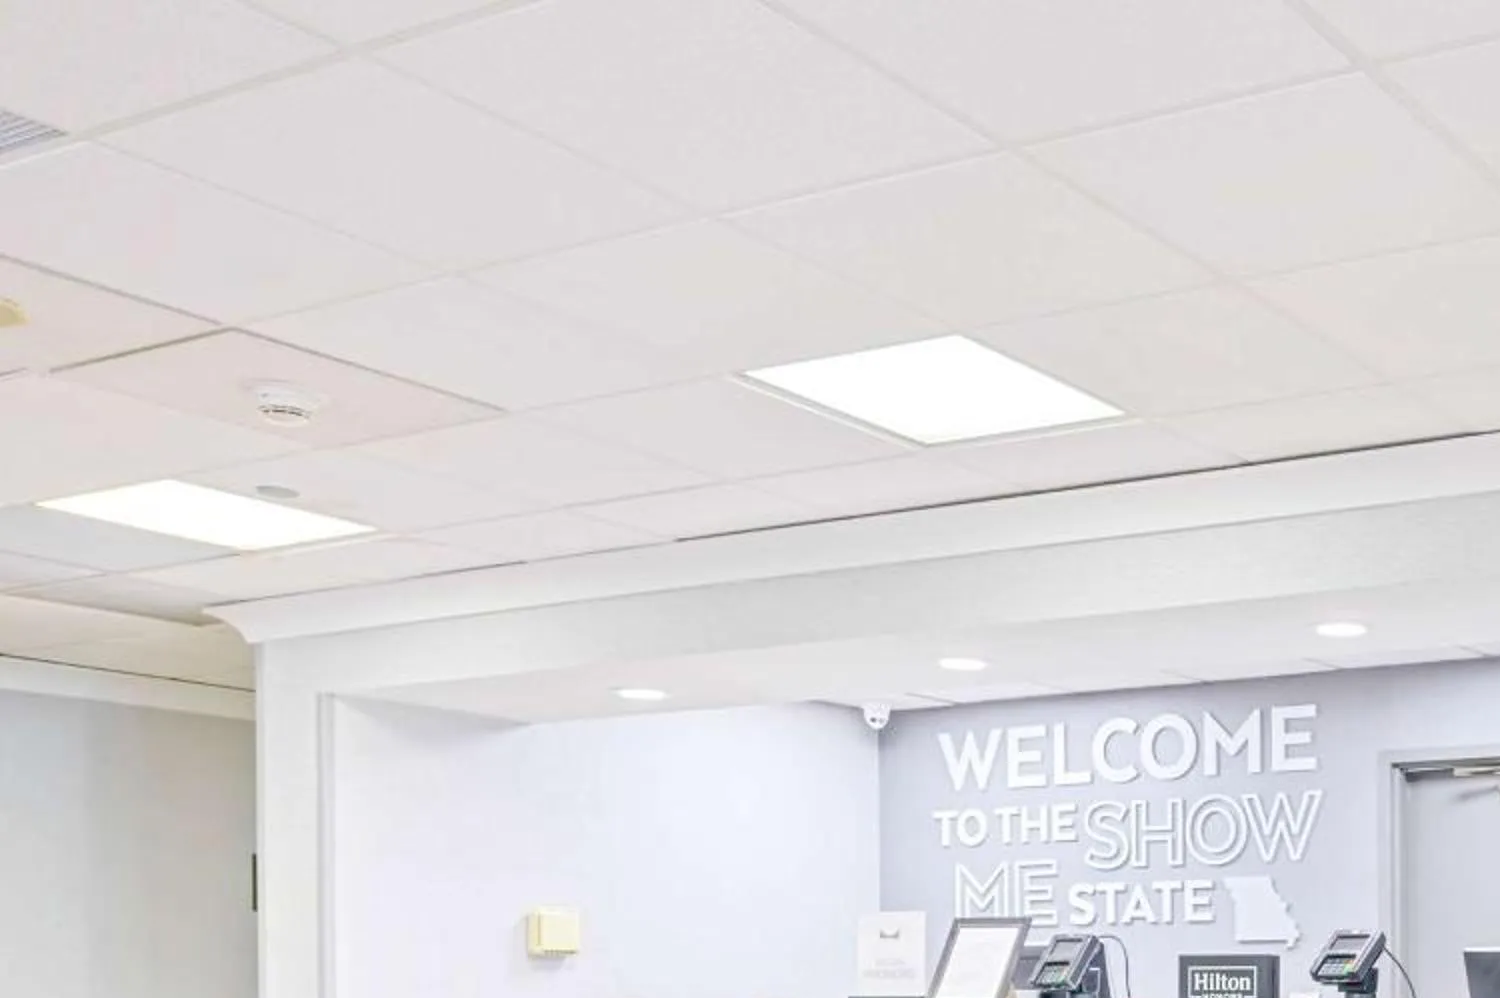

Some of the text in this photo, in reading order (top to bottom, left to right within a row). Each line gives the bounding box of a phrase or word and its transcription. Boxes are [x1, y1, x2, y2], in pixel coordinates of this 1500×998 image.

[938, 704, 1318, 791] WELCOME
[932, 790, 1322, 870] TO THE SHOW
[954, 858, 1215, 927] ME STATE
[1193, 971, 1251, 991] Hilton
